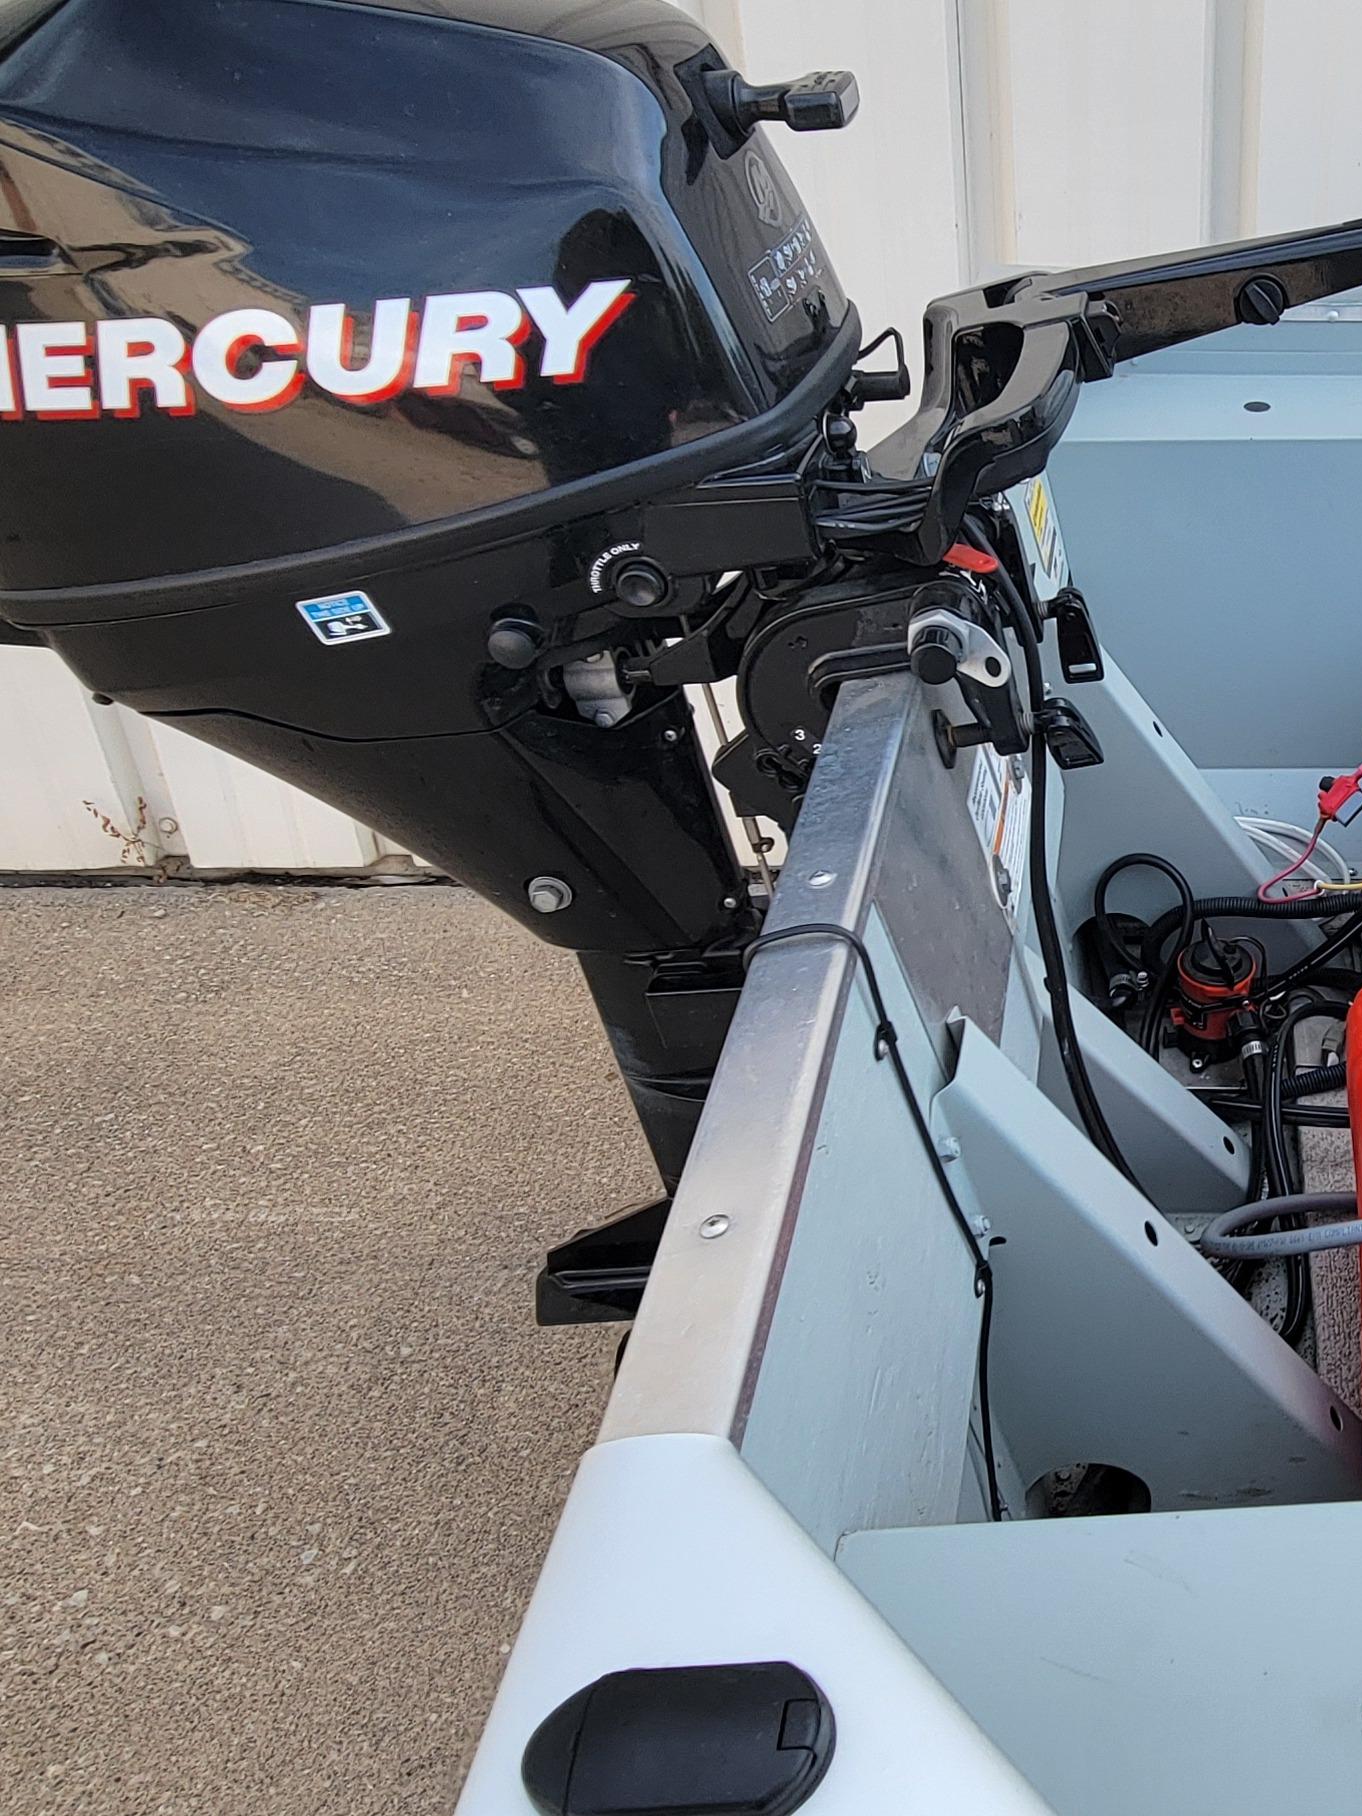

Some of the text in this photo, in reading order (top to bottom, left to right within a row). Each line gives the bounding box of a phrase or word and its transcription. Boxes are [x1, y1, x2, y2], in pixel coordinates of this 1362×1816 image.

[0, 279, 636, 418] ERCURY
[610, 542, 640, 556] ONLY
[795, 729, 805, 740] 3
[812, 743, 822, 754] 2
